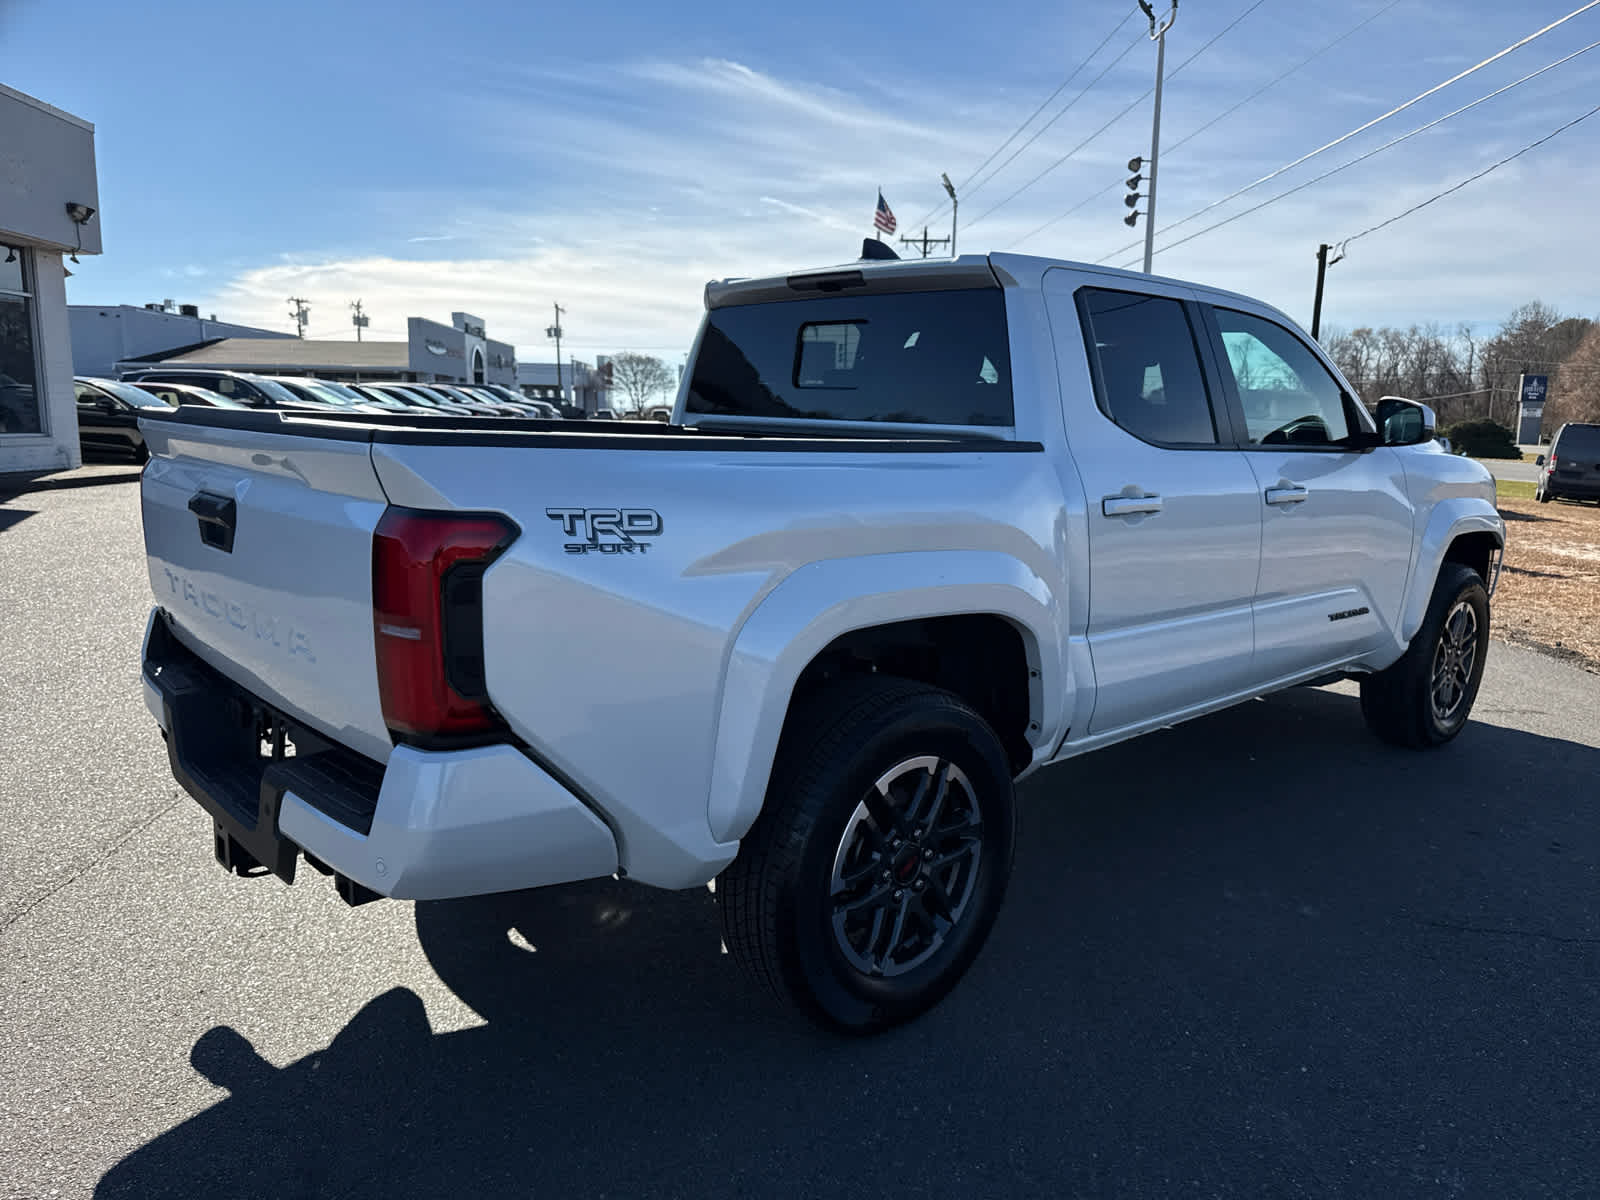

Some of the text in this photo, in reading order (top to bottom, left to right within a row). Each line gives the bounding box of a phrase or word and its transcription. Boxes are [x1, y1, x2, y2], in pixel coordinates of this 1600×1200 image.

[545, 507, 664, 543] TRD
[563, 542, 652, 554] SPORT
[164, 567, 317, 664] TACOMA
